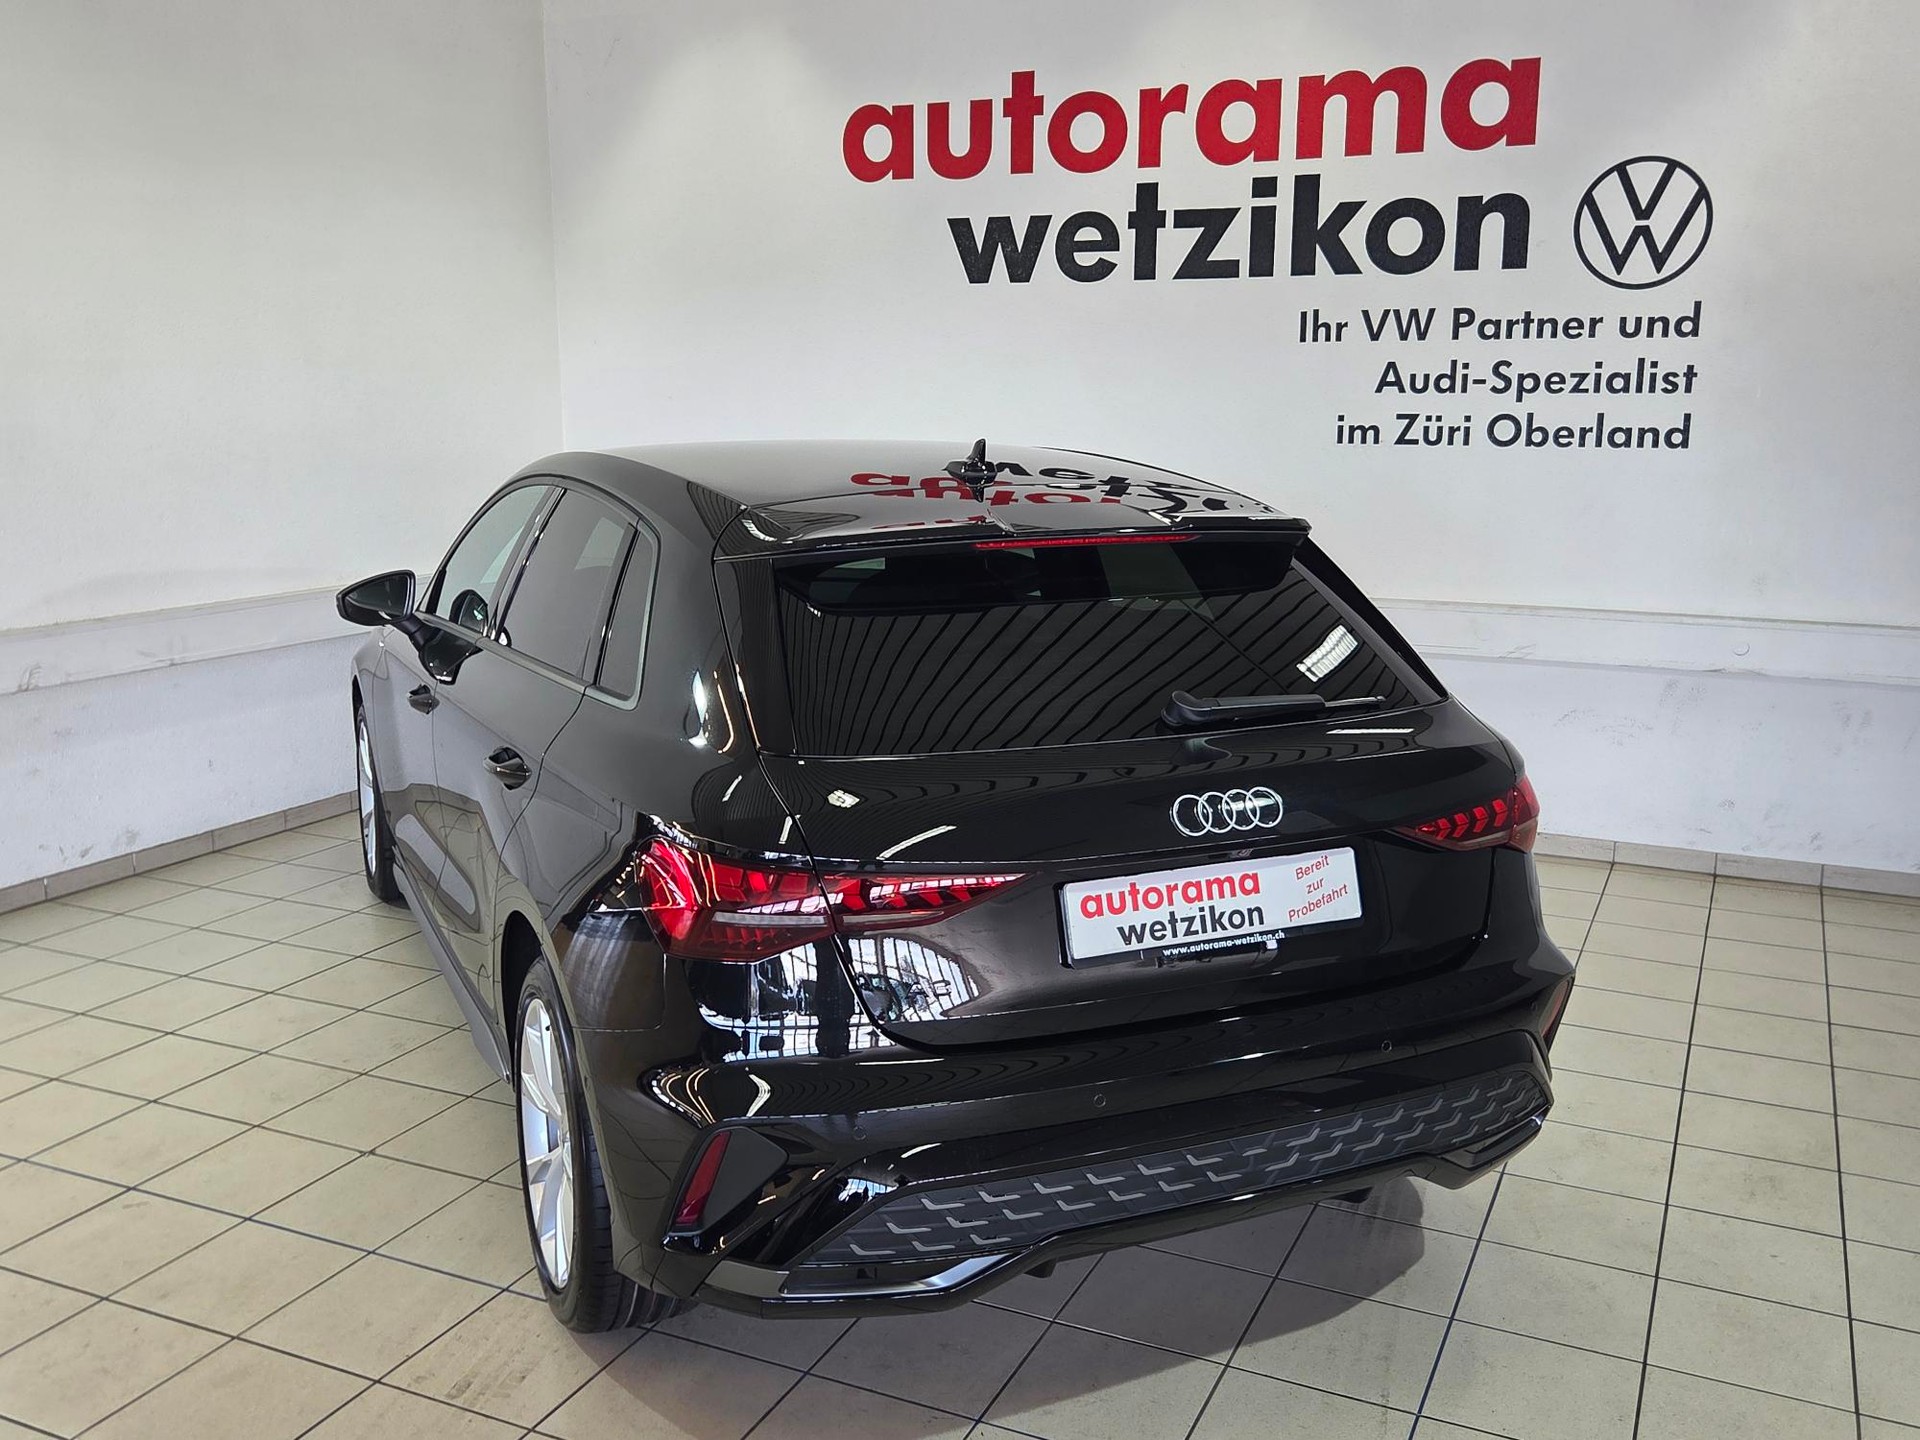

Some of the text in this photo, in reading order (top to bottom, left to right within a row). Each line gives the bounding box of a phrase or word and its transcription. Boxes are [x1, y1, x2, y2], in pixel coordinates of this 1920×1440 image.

[842, 56, 1542, 183] autorama
[946, 173, 1531, 284] wetzikon
[1299, 300, 1703, 343] Ihr VW Partner und
[1374, 357, 1698, 403] Audi-Spezialist
[1336, 411, 1692, 450] im Züri Oberland
[1295, 854, 1330, 881] Bereit
[1305, 877, 1325, 895] zur
[1080, 872, 1261, 919] autorama
[1288, 883, 1349, 923] Probefahrt
[1116, 904, 1266, 946] wetzikon
[1162, 930, 1286, 957] www.autorama-wetzikon.ch
